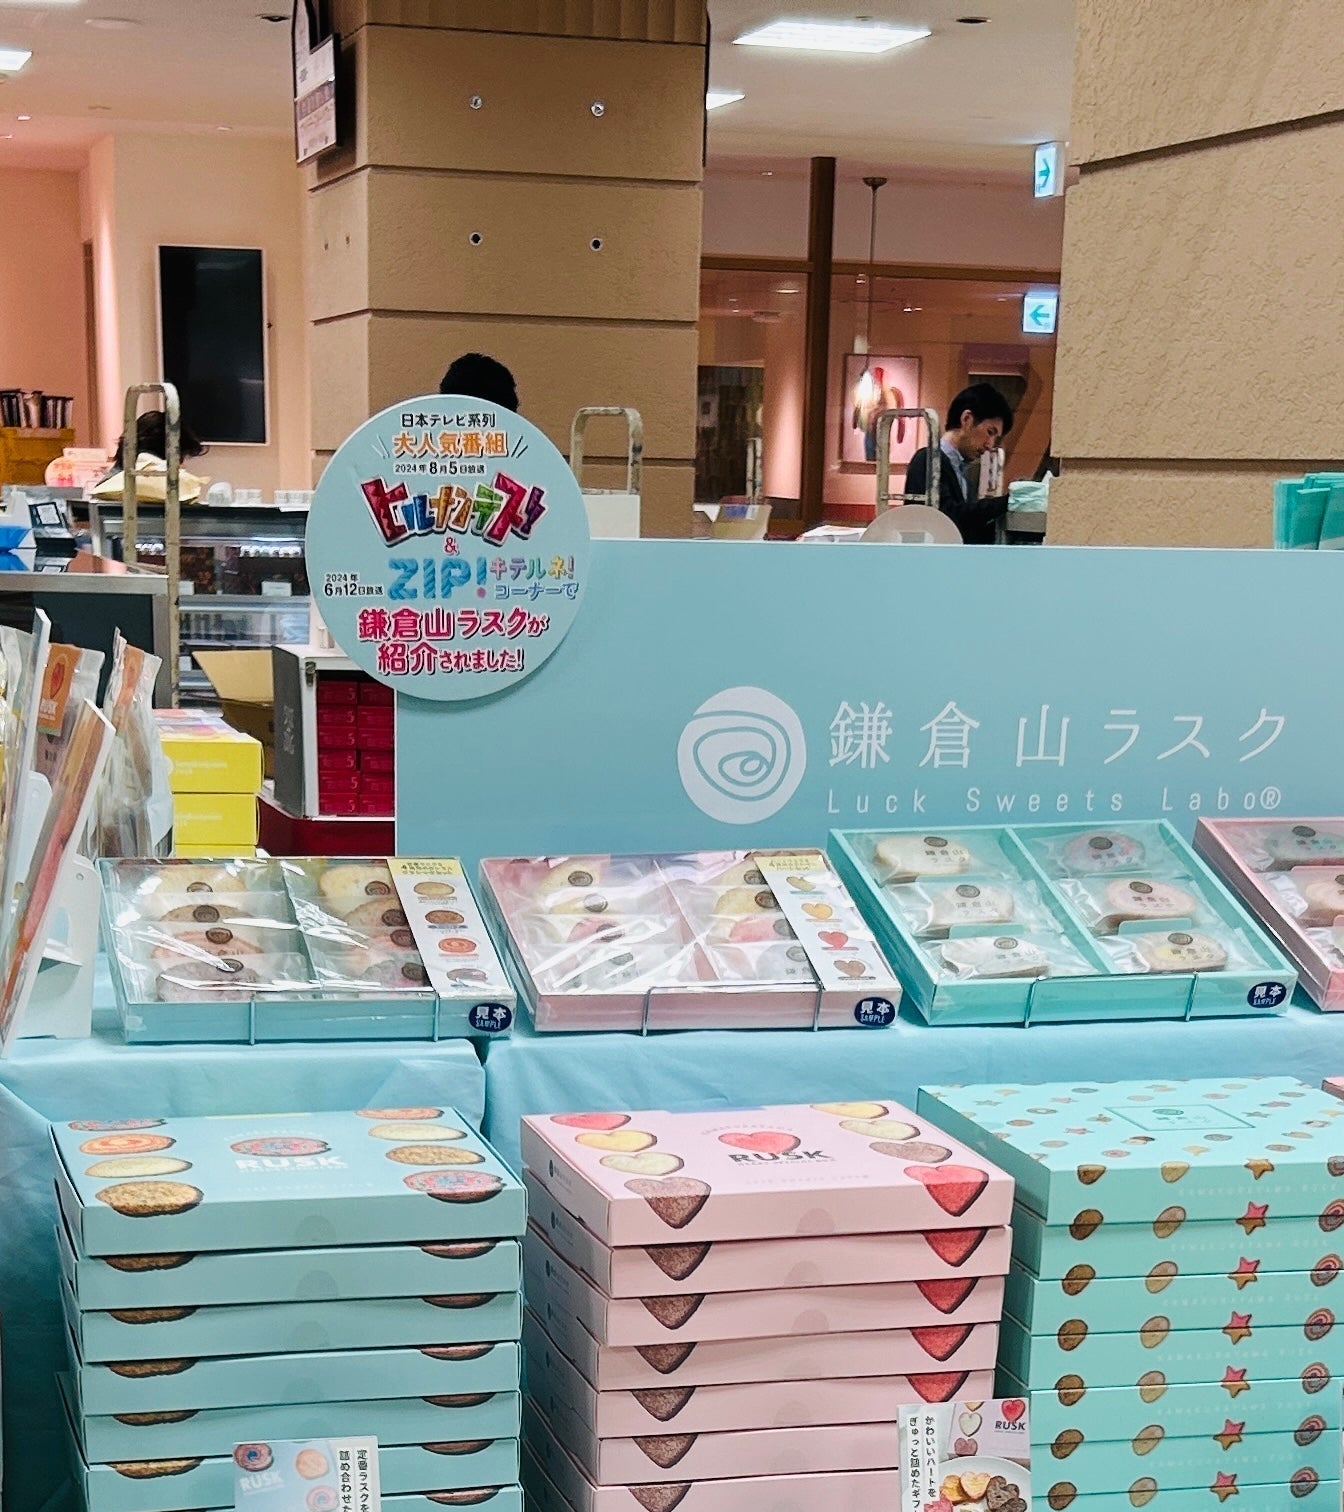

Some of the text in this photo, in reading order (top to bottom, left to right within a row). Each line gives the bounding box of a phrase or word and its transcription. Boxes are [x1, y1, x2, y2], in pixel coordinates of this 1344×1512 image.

[401, 412, 496, 429] 日本テレビ系列
[393, 431, 508, 458] 大人気番組
[444, 536, 460, 555] &
[387, 556, 488, 601] ZIP!
[358, 606, 550, 641] 鎌倉山ラスクが
[828, 787, 927, 814] Luck
[966, 787, 1123, 813] Sweets
[1253, 984, 1283, 999] 見本
[475, 1006, 507, 1021] 見本
[860, 1000, 891, 1015] 見本
[234, 1155, 349, 1169] RUSK
[728, 1150, 834, 1163] RUSK
[995, 1420, 1026, 1431] RUSK
[925, 1415, 937, 1498] かわいいハートを
[240, 1472, 284, 1492] RUSK
